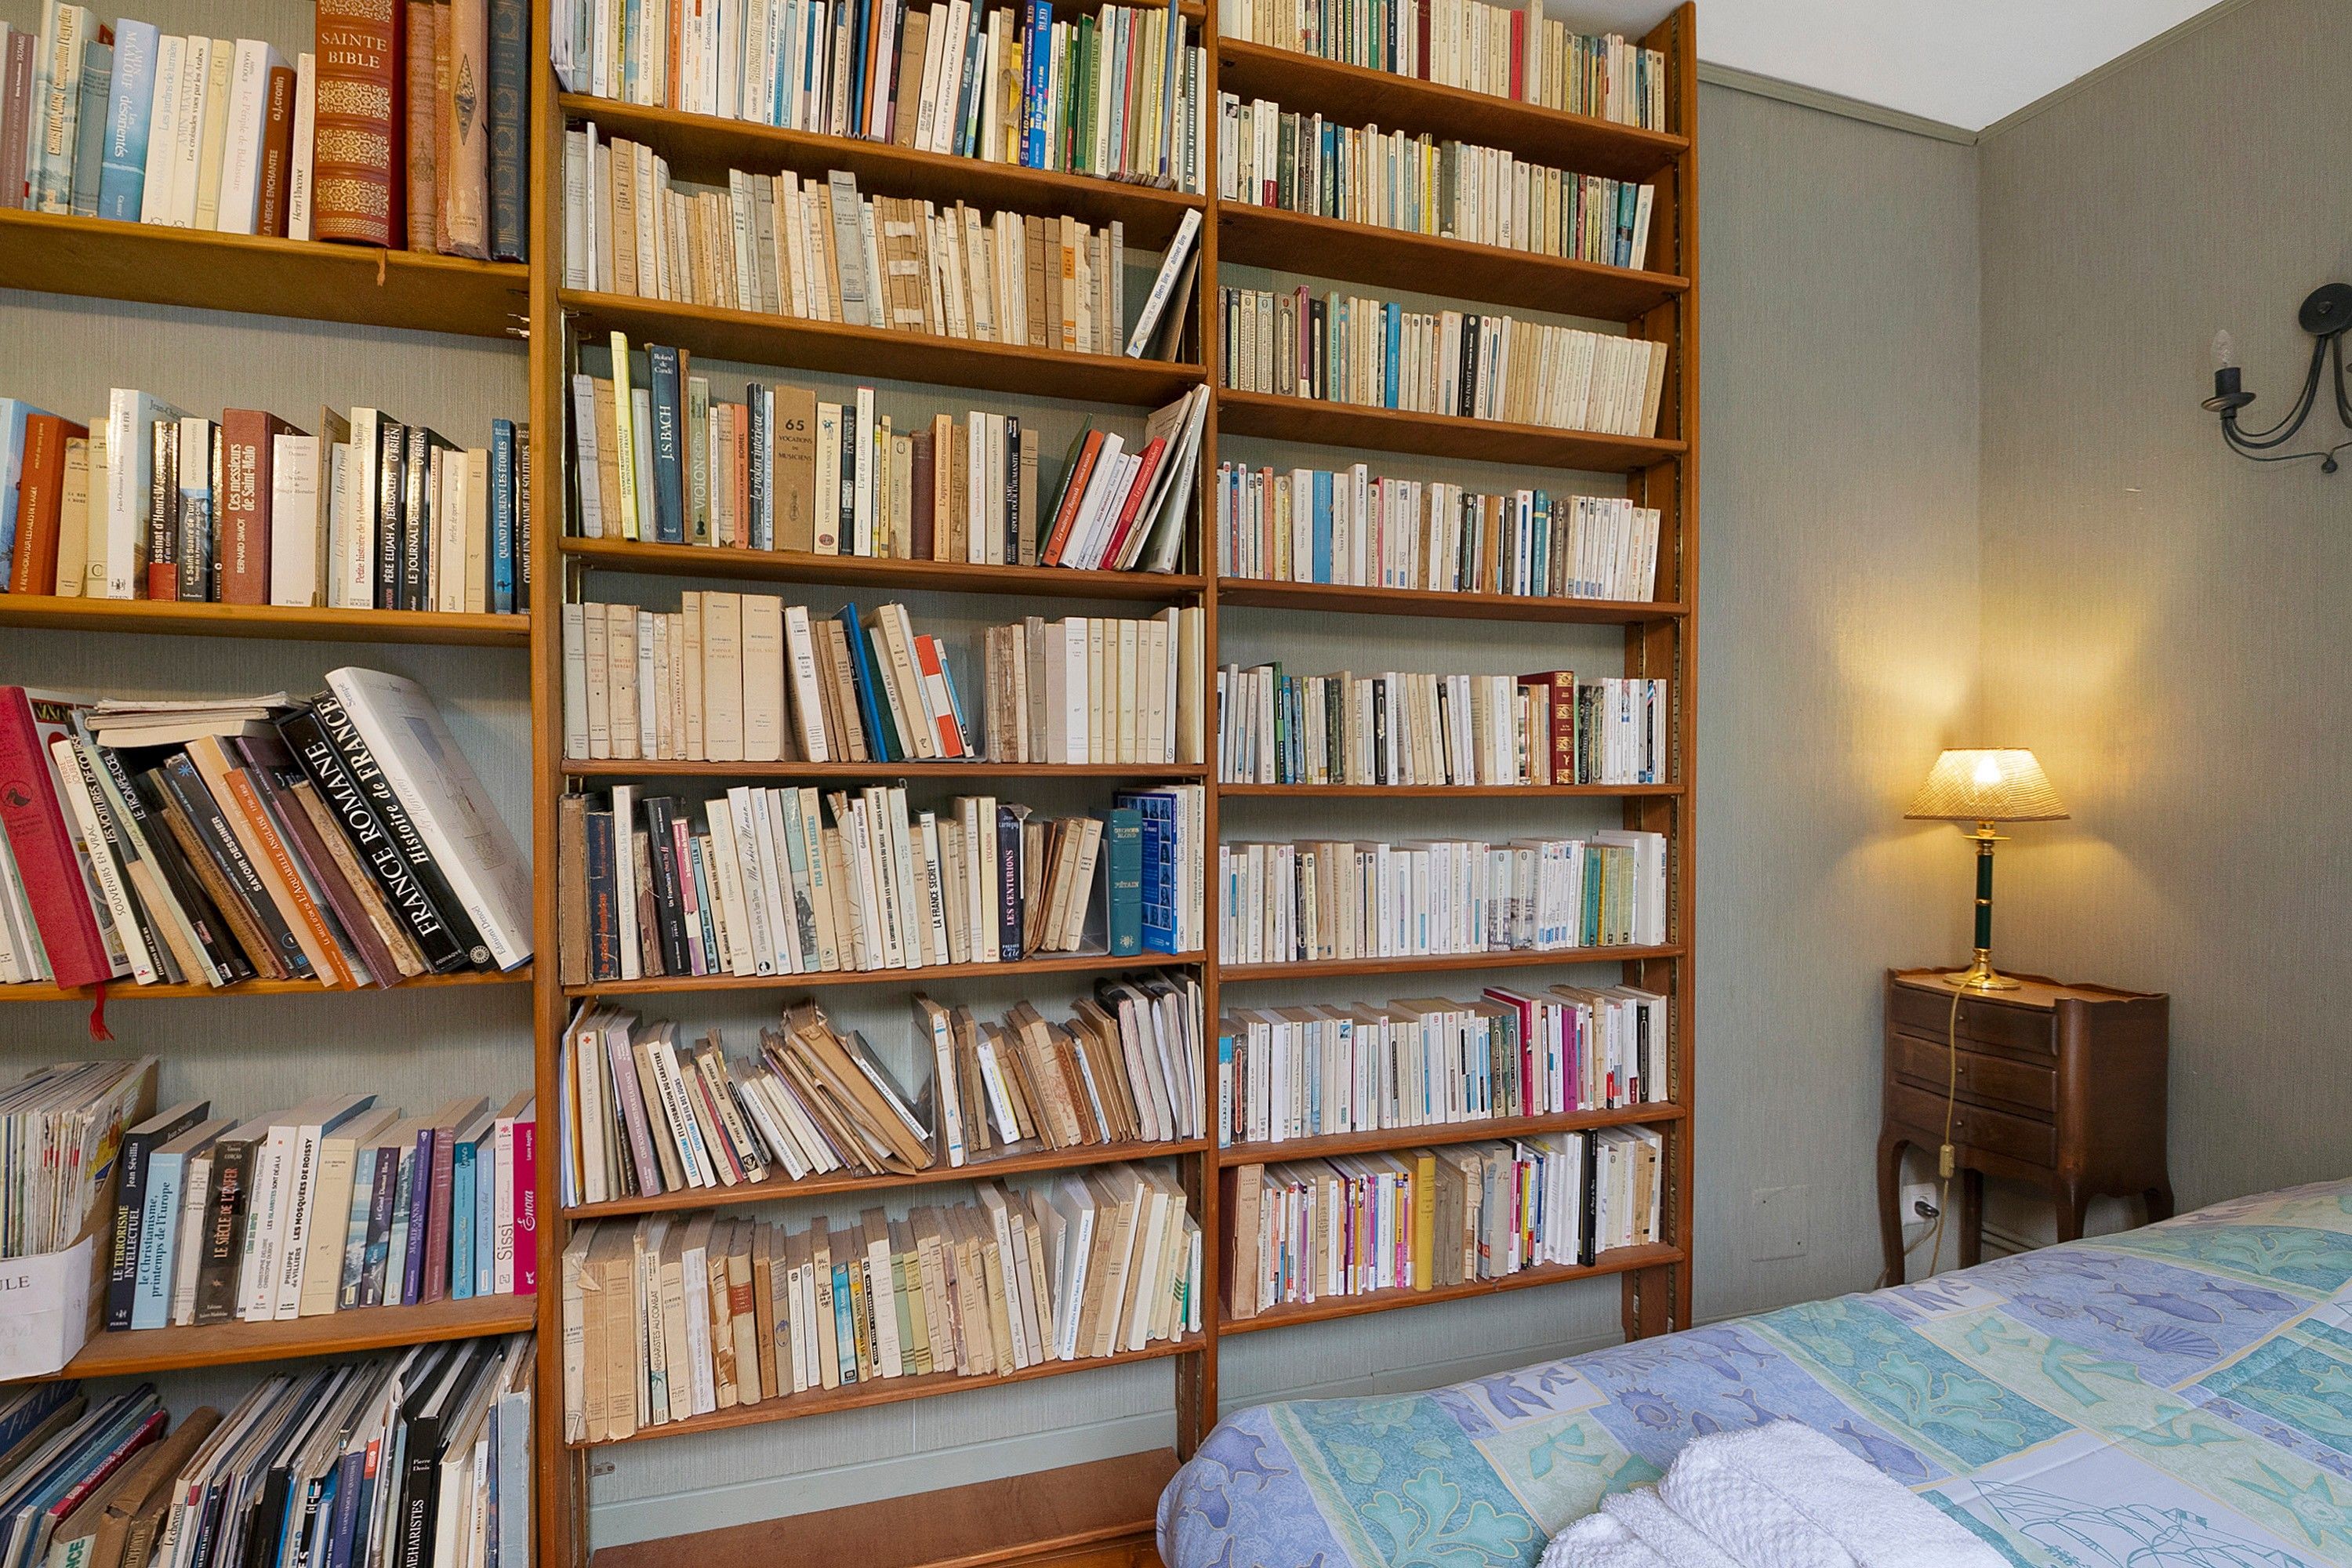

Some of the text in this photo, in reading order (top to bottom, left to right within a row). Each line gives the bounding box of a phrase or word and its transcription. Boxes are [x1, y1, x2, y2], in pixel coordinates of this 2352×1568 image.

[1037, 8, 1048, 31] BLED
[321, 32, 388, 53] SAINTE
[122, 31, 139, 89] MAALOUF
[194, 47, 204, 72] Arabes
[328, 50, 380, 69] BIBLE
[192, 73, 201, 83] les
[192, 84, 201, 96] par
[115, 95, 132, 158] désorientés
[188, 114, 198, 147] croisades
[186, 148, 195, 162] Les
[263, 149, 278, 235] LA NEIGE ENCHANTEE
[1160, 272, 1171, 286] lire
[1178, 234, 1187, 247] lire
[654, 353, 673, 362] Roland
[1464, 371, 1472, 396] FOLLETT
[355, 422, 364, 450] Vladimir
[785, 419, 805, 431] 65
[390, 427, 401, 461] O'BRIEN
[416, 431, 424, 465] O'BRIEN
[779, 436, 813, 445] VOCATIONS
[749, 413, 763, 499] le violon intérieur
[779, 452, 813, 462] MUSICIENS
[858, 462, 866, 472] du
[228, 443, 241, 510] Ces messieurs
[241, 445, 256, 510] de Saint-Malo
[336, 473, 346, 495] Henri
[694, 459, 706, 510] VIOLON
[383, 472, 397, 520] JÉRUSALEM
[496, 441, 507, 558] QUAND PLEURENT LES ÉTOILES
[523, 488, 531, 499] DE
[186, 497, 194, 585] Le Saint Suaire de Turin
[357, 523, 365, 534] de
[237, 517, 245, 574] BERNARD SIMIOT
[356, 534, 365, 561] histoire
[385, 532, 395, 561] ELIJAH
[408, 528, 419, 572] JOURNAL
[523, 541, 531, 552] UN
[356, 563, 365, 583] Petite
[383, 562, 394, 583] PÈRE
[409, 573, 419, 584] LE
[337, 680, 356, 708] Sempé
[318, 695, 430, 865] Histoire de FRANCE
[306, 740, 441, 938] FRANCE ROMANE
[808, 815, 818, 846] RIZIÈRE
[211, 816, 263, 892] SAVOIR DESSINER
[746, 841, 757, 862] chère
[812, 847, 819, 857] LA
[814, 858, 821, 869] DE
[85, 825, 125, 916] SOUVENIRS EN VRAC
[1005, 849, 1014, 926] LES CENTURIONS
[930, 890, 941, 917] FRANCE
[933, 919, 942, 929] LA
[126, 1142, 139, 1188] Jean Sévillia
[302, 1138, 313, 1169] ROISSY
[222, 1167, 238, 1203] L'ENFER
[301, 1169, 309, 1181] DE
[222, 1203, 232, 1214] DE
[125, 1207, 140, 1278] INTELLECTUEL
[151, 1181, 173, 1298] printemps de l'Europe
[408, 1201, 420, 1254] MARIE-ANNE
[496, 1223, 514, 1261] Sissi
[112, 1204, 129, 1282] LE TERRORISME
[213, 1247, 227, 1258] LE
[138, 1274, 150, 1286] le
[257, 1258, 267, 1290] CHRISTOPHE
[285, 1250, 295, 1285] PHILIPPE
[290, 1247, 302, 1288] de VILLIERS
[651, 1290, 659, 1319] COMBAT
[164, 1503, 183, 1546] Le chevreuil
